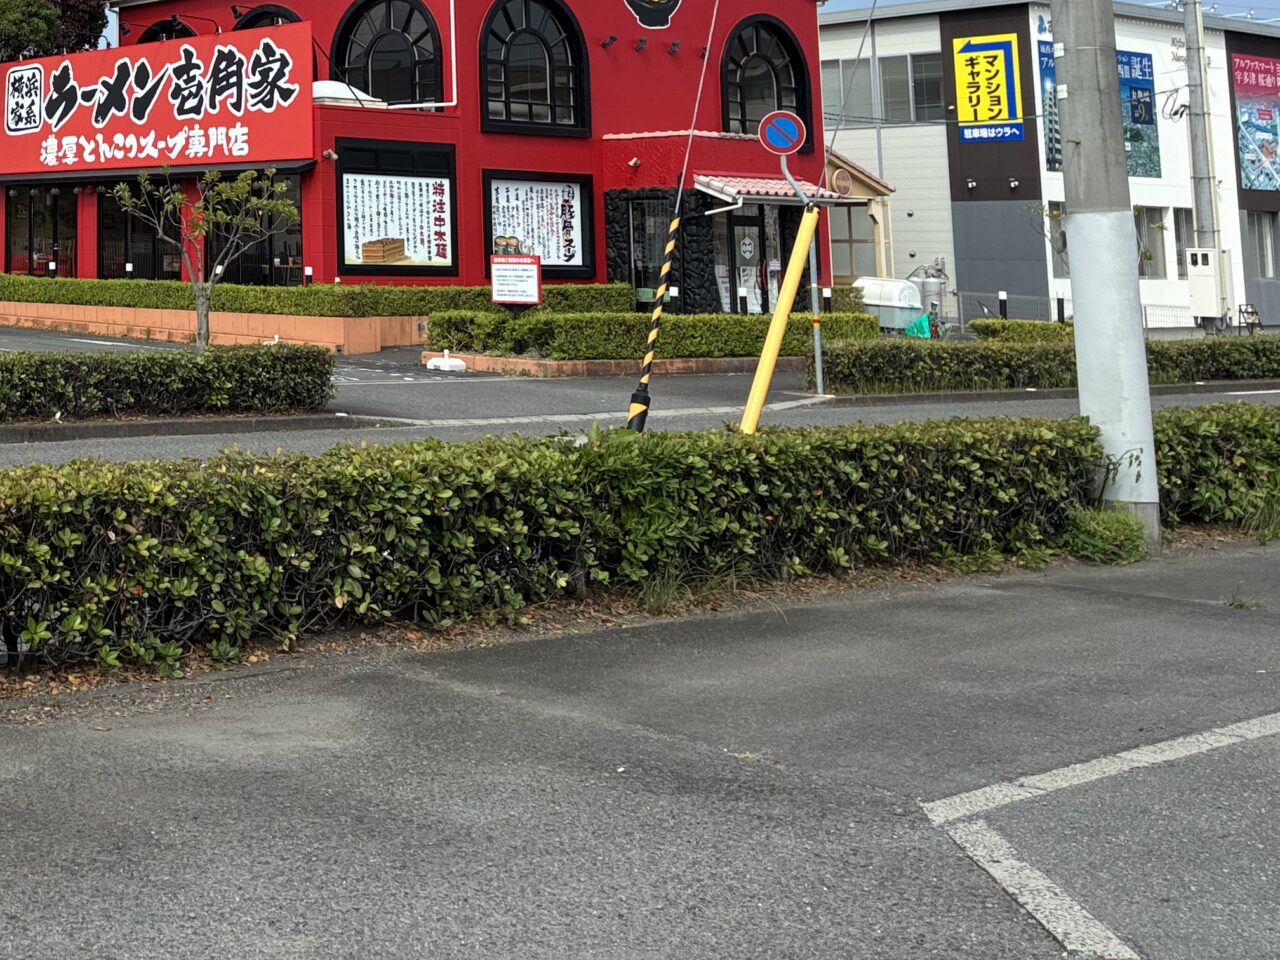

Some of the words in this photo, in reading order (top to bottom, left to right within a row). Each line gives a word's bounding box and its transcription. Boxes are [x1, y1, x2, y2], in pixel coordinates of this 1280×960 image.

[964, 55, 981, 121] ギャラリー
[983, 54, 1002, 120] マンション
[1131, 56, 1153, 80] 誕生
[40, 124, 249, 166] 濃厚とんこつスープ専門店
[963, 126, 1020, 139] 駐車場はウラへ
